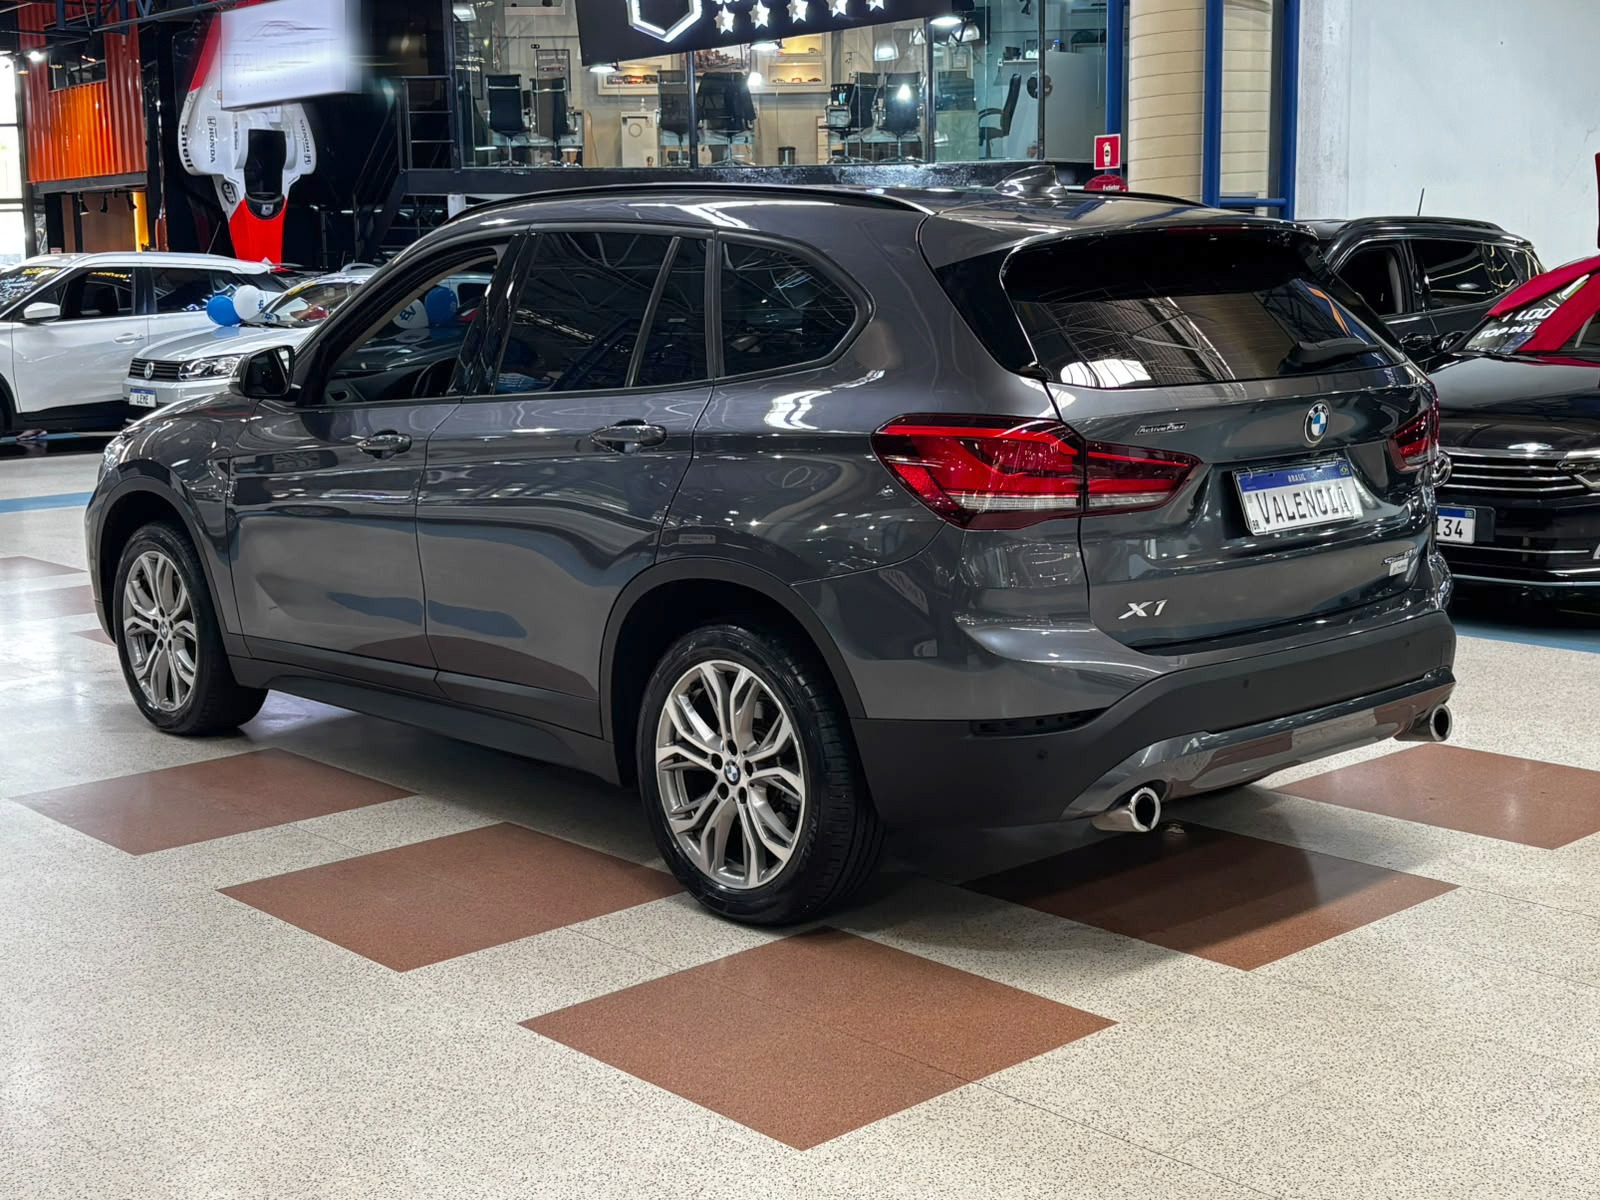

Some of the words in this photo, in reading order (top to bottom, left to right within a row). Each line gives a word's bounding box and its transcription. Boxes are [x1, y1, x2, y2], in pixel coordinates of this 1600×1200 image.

[208, 128, 217, 164] HONDA
[1477, 327, 1509, 340] TOP
[1255, 486, 1353, 525] VALENCIA
[1436, 518, 1464, 539] 34
[1118, 599, 1168, 619] X1
